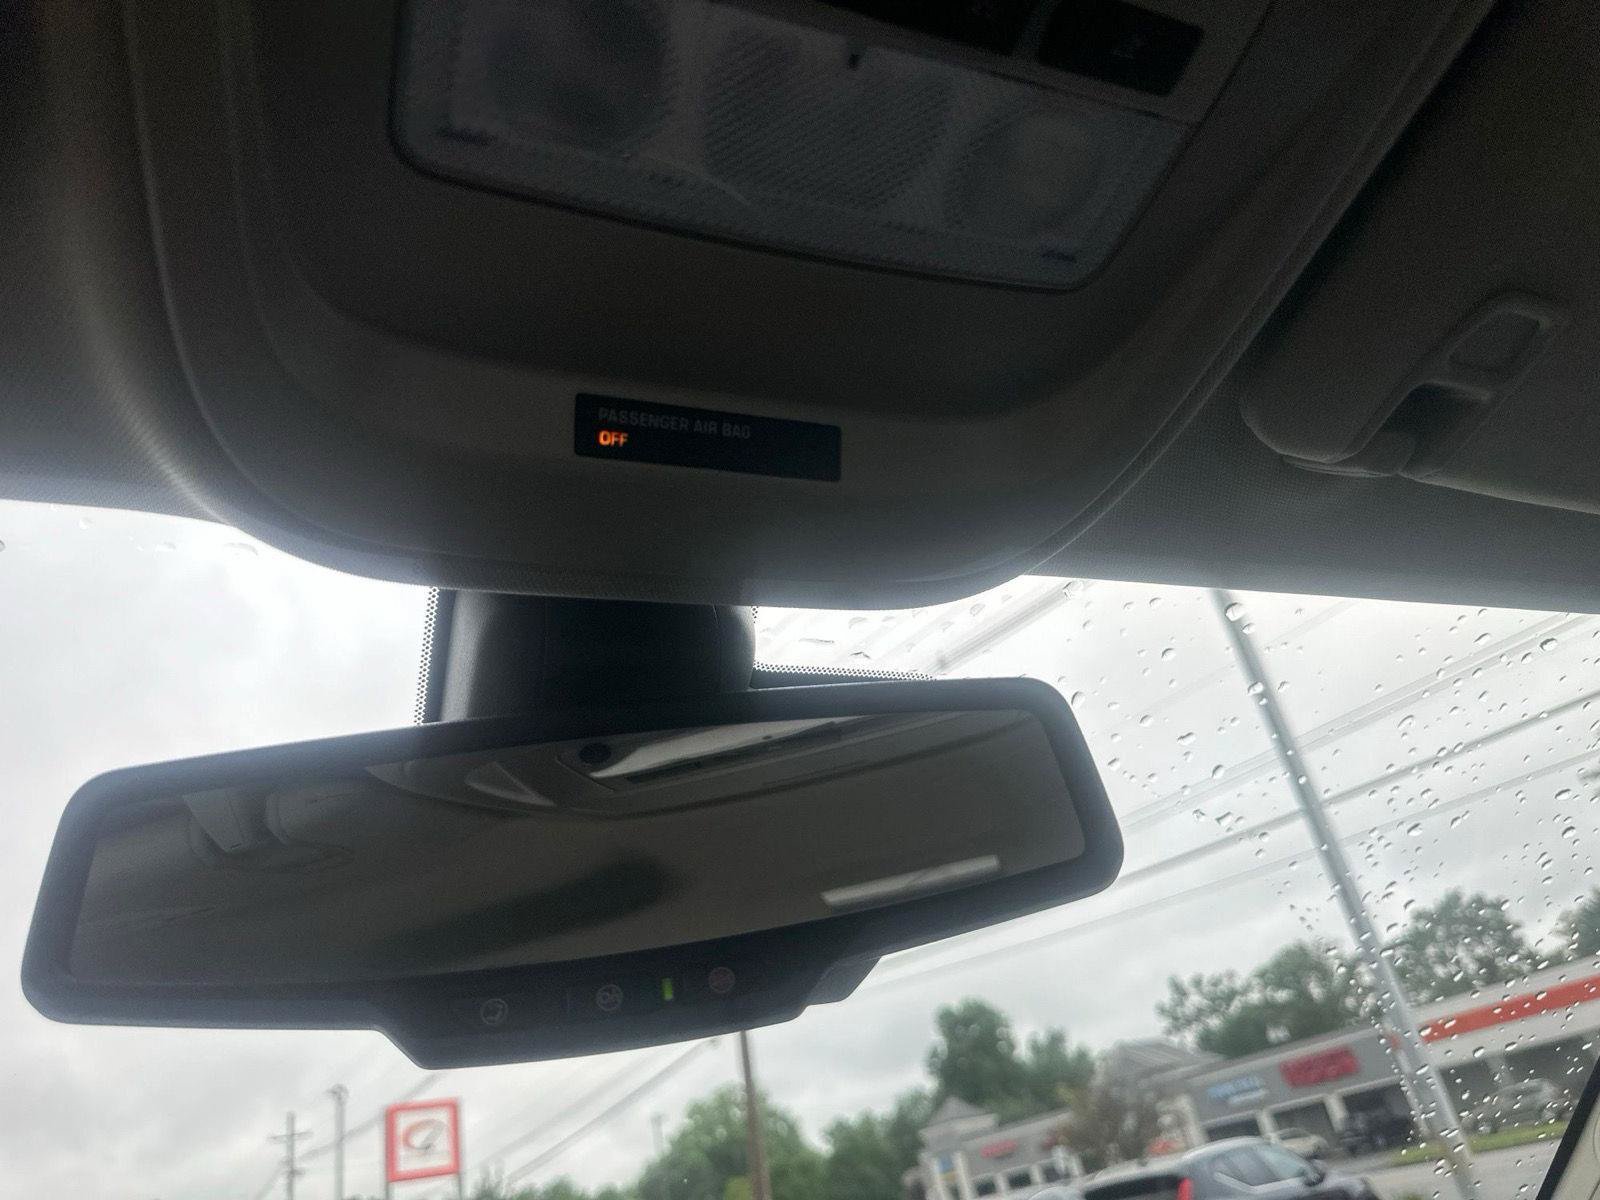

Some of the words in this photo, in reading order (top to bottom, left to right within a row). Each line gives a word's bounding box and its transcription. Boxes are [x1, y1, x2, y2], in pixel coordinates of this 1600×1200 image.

[598, 407, 689, 431] PASSENGER
[693, 420, 718, 434] AIR
[722, 422, 751, 440] BAG
[598, 430, 629, 447] OFF
